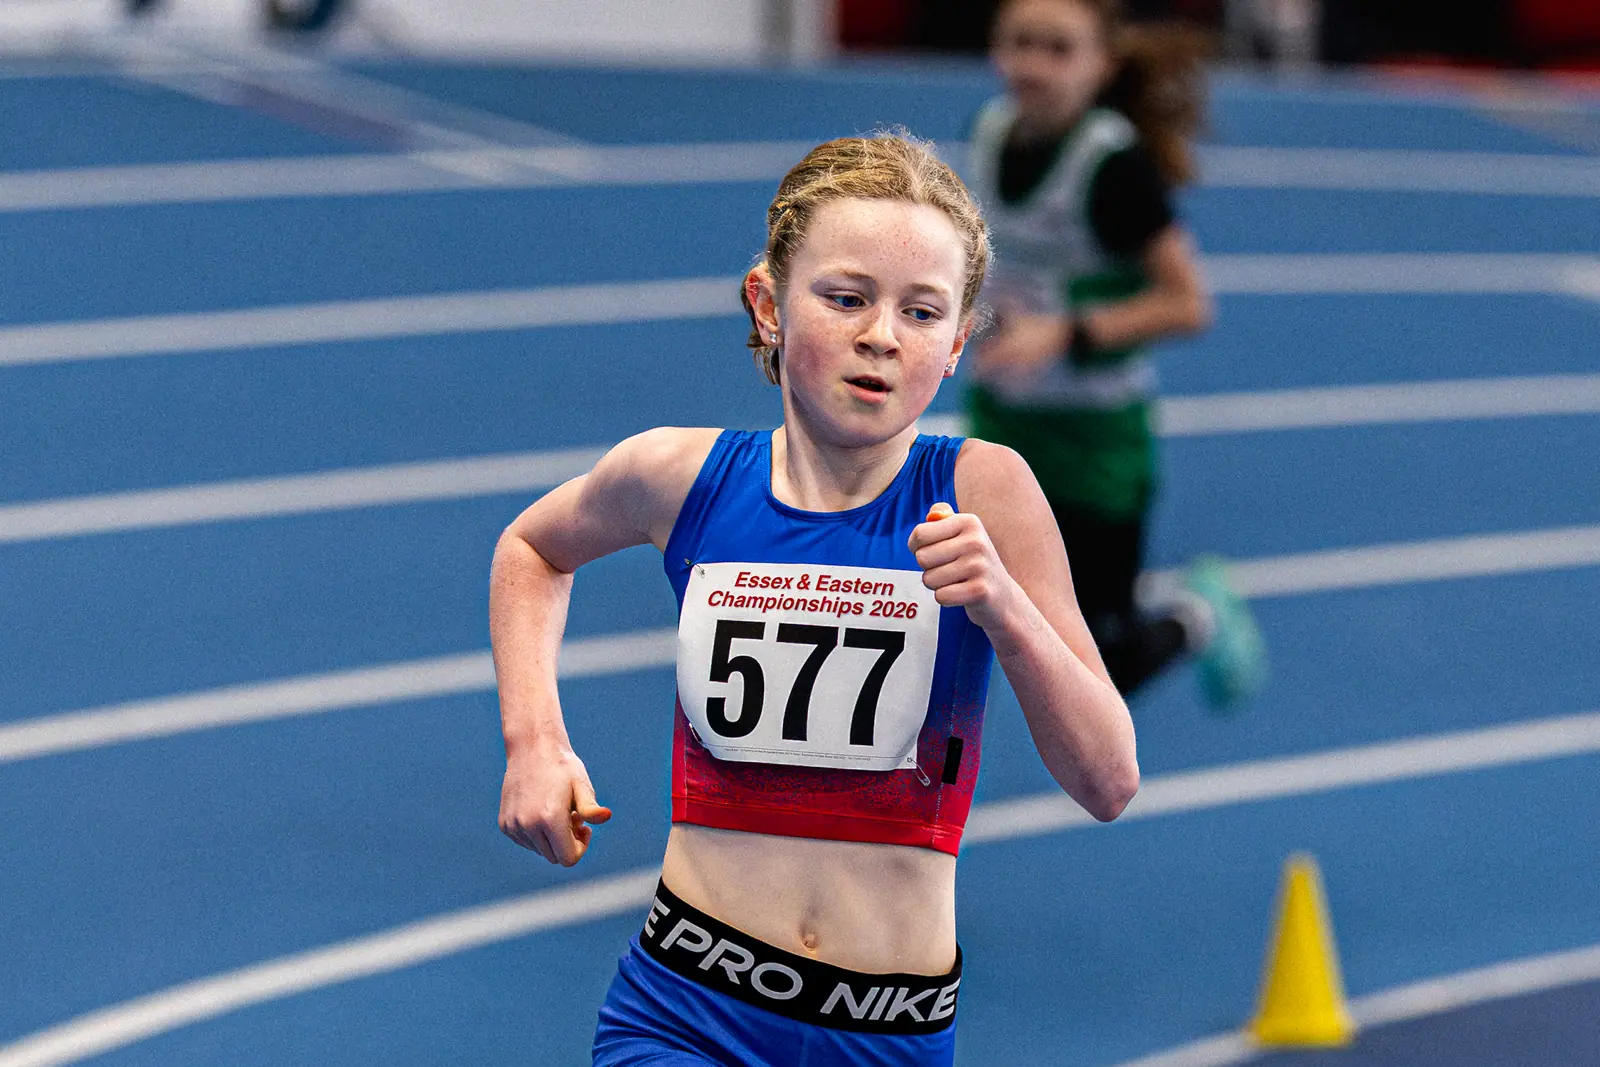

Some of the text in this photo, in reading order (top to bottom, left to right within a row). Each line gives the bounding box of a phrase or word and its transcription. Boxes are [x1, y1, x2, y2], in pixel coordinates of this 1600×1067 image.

[707, 590, 919, 619] Championships 2026
[734, 571, 895, 596] Essex & Eastern
[706, 619, 906, 746] 577
[659, 918, 803, 1000] PRO
[819, 977, 961, 1022] NIKE
